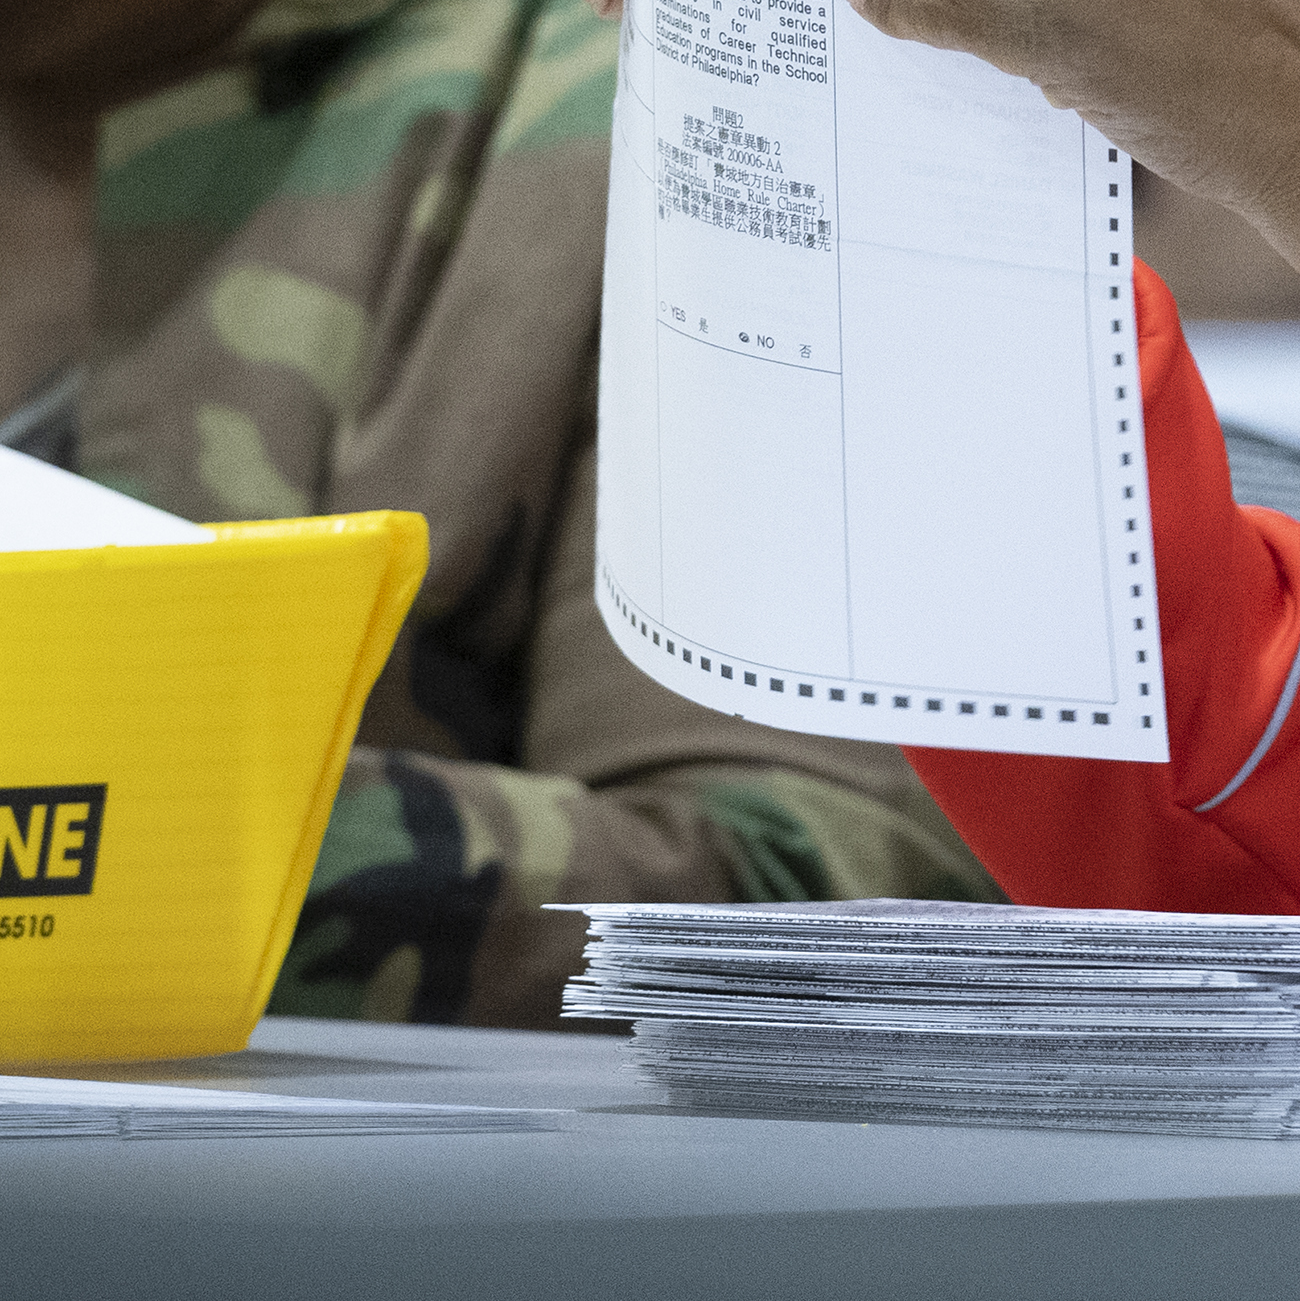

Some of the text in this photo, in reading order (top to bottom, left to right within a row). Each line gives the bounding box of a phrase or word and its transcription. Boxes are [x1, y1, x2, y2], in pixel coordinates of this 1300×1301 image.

[738, 5, 761, 21] civil
[780, 16, 826, 34] service
[818, 8, 826, 17] a
[656, 7, 827, 68] graduates of Career Technical
[731, 18, 747, 34] for
[771, 31, 826, 51] qualified
[681, 51, 690, 65] of
[692, 56, 759, 86] Philadelphia?
[696, 43, 743, 66] programs
[748, 57, 758, 70] in
[762, 60, 780, 75] the
[786, 64, 827, 84] School
[727, 148, 784, 174] 200006-AA
[773, 141, 781, 156] 2
[713, 179, 741, 199] Home
[748, 188, 770, 206] Rule
[777, 195, 824, 218] Charter)
[671, 304, 812, 359] YES 是 NO 否
